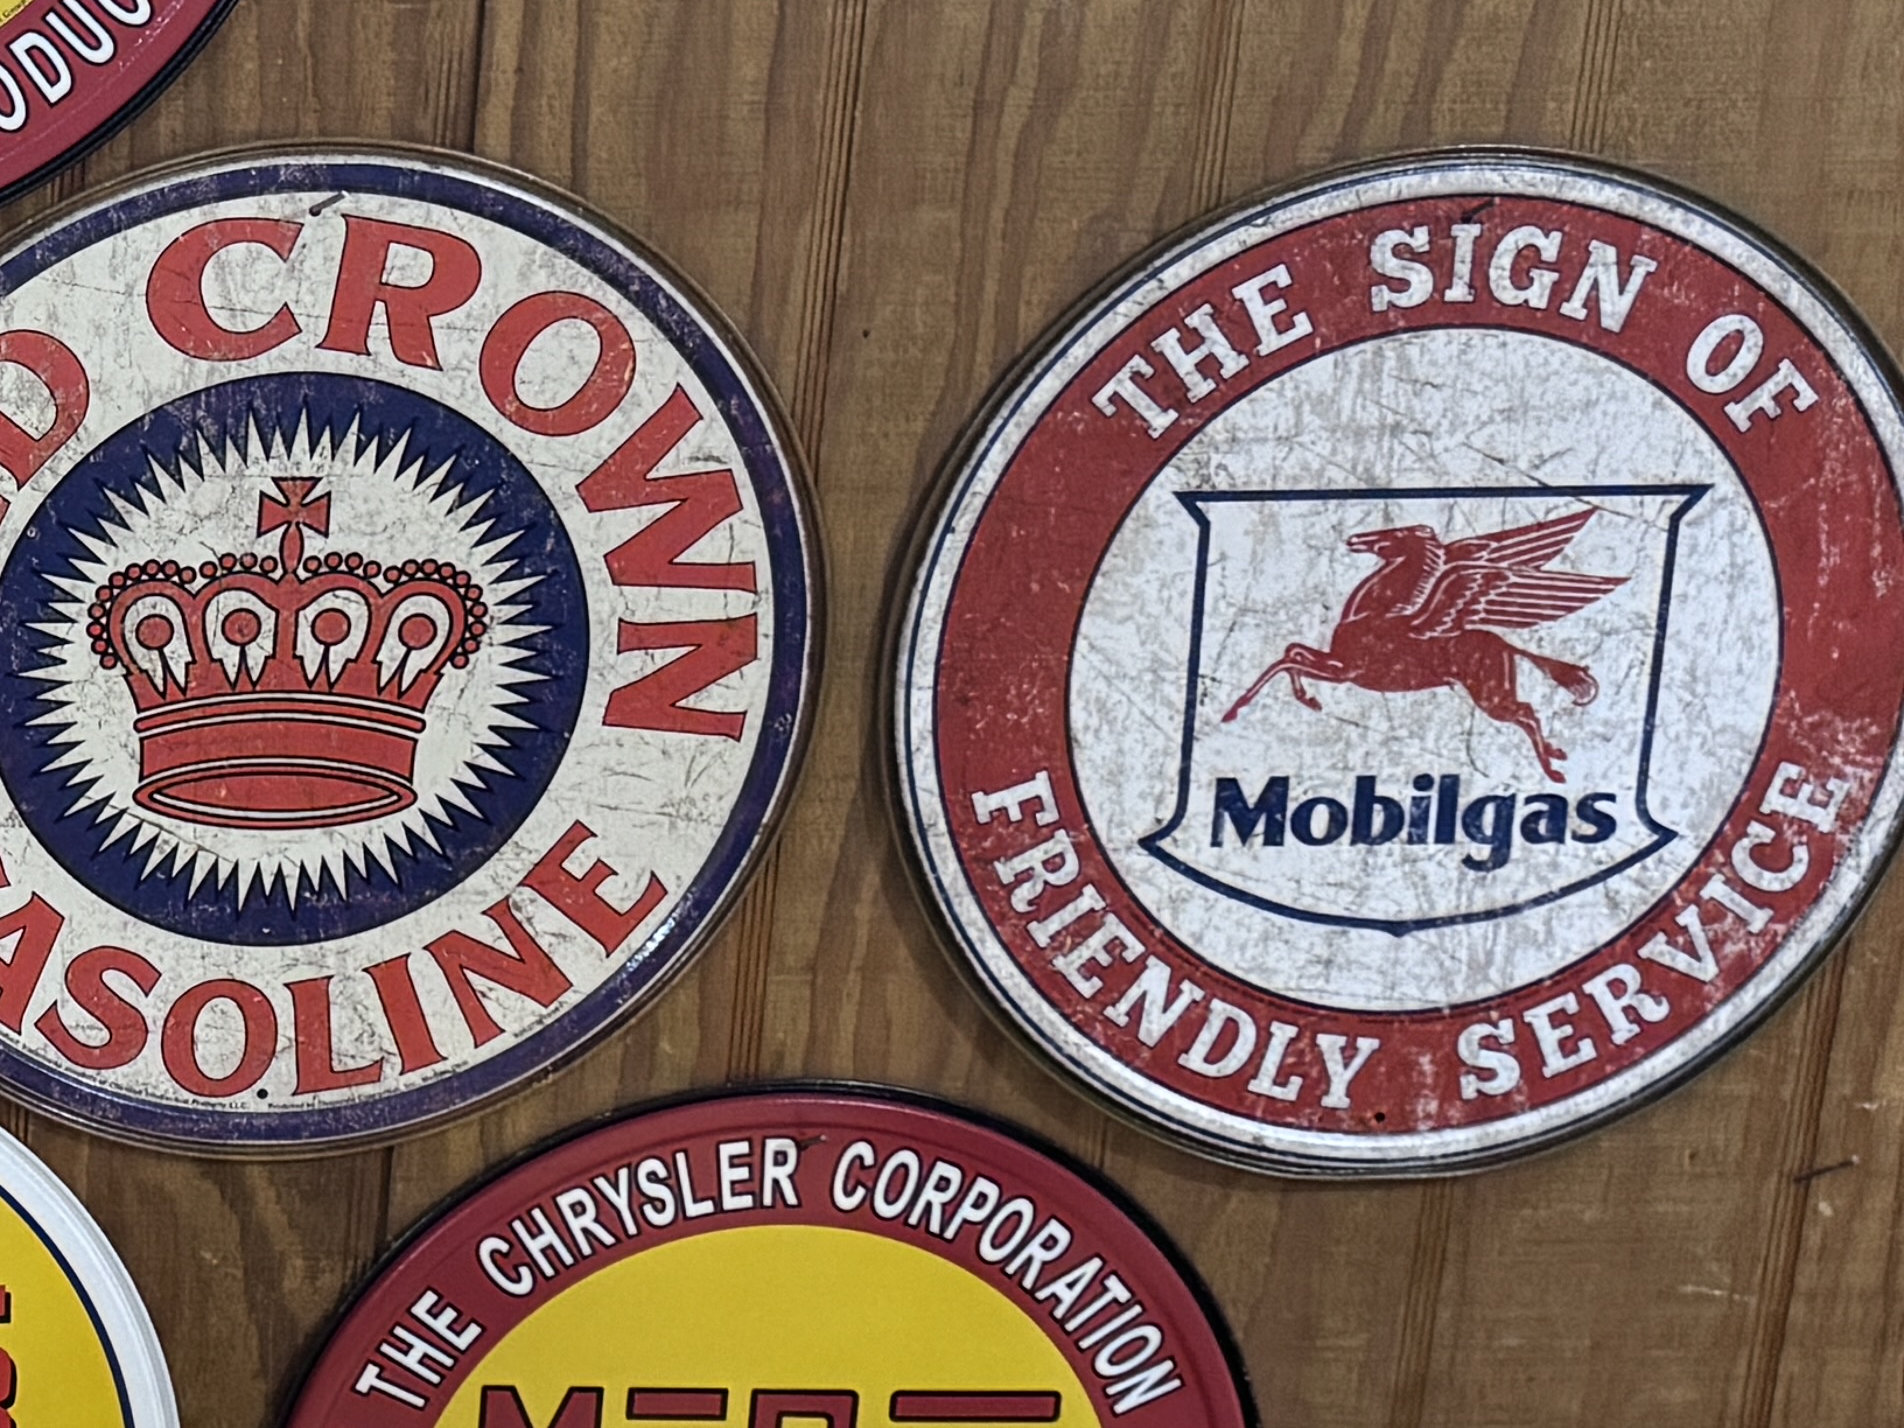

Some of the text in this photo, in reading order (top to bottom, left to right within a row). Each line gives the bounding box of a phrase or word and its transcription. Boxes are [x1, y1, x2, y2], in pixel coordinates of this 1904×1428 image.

[1090, 221, 1819, 441] THE SIGN OF
[145, 214, 758, 741] CROWN
[971, 761, 1852, 1111] FRIENDLY SERVICE
[1210, 774, 1621, 871] Mobilgas
[355, 1137, 1182, 1418] THE CHRYSLER CORPORATION
